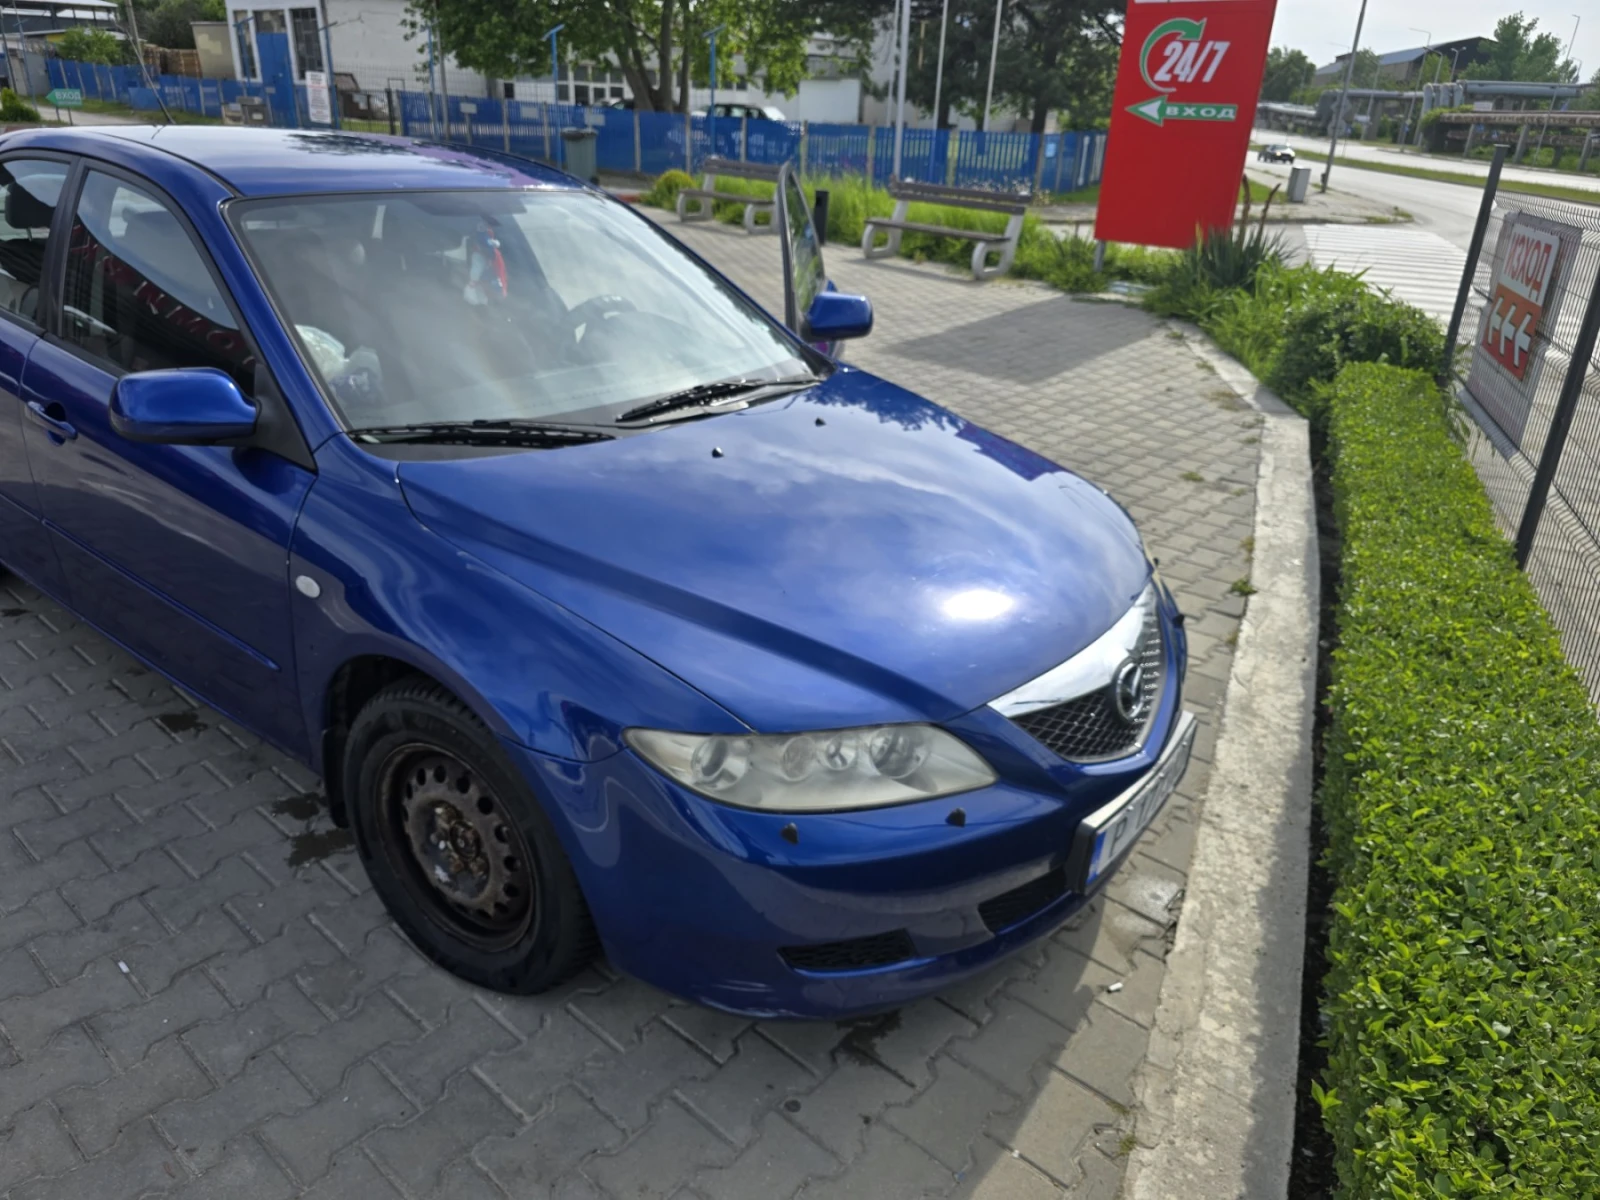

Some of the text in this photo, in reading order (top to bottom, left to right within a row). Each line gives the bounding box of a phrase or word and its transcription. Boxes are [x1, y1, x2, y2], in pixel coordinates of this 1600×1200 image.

[1154, 40, 1231, 83] 24/7
[1165, 105, 1236, 120] ВХОД
[1504, 232, 1553, 302] ИЗХОД
